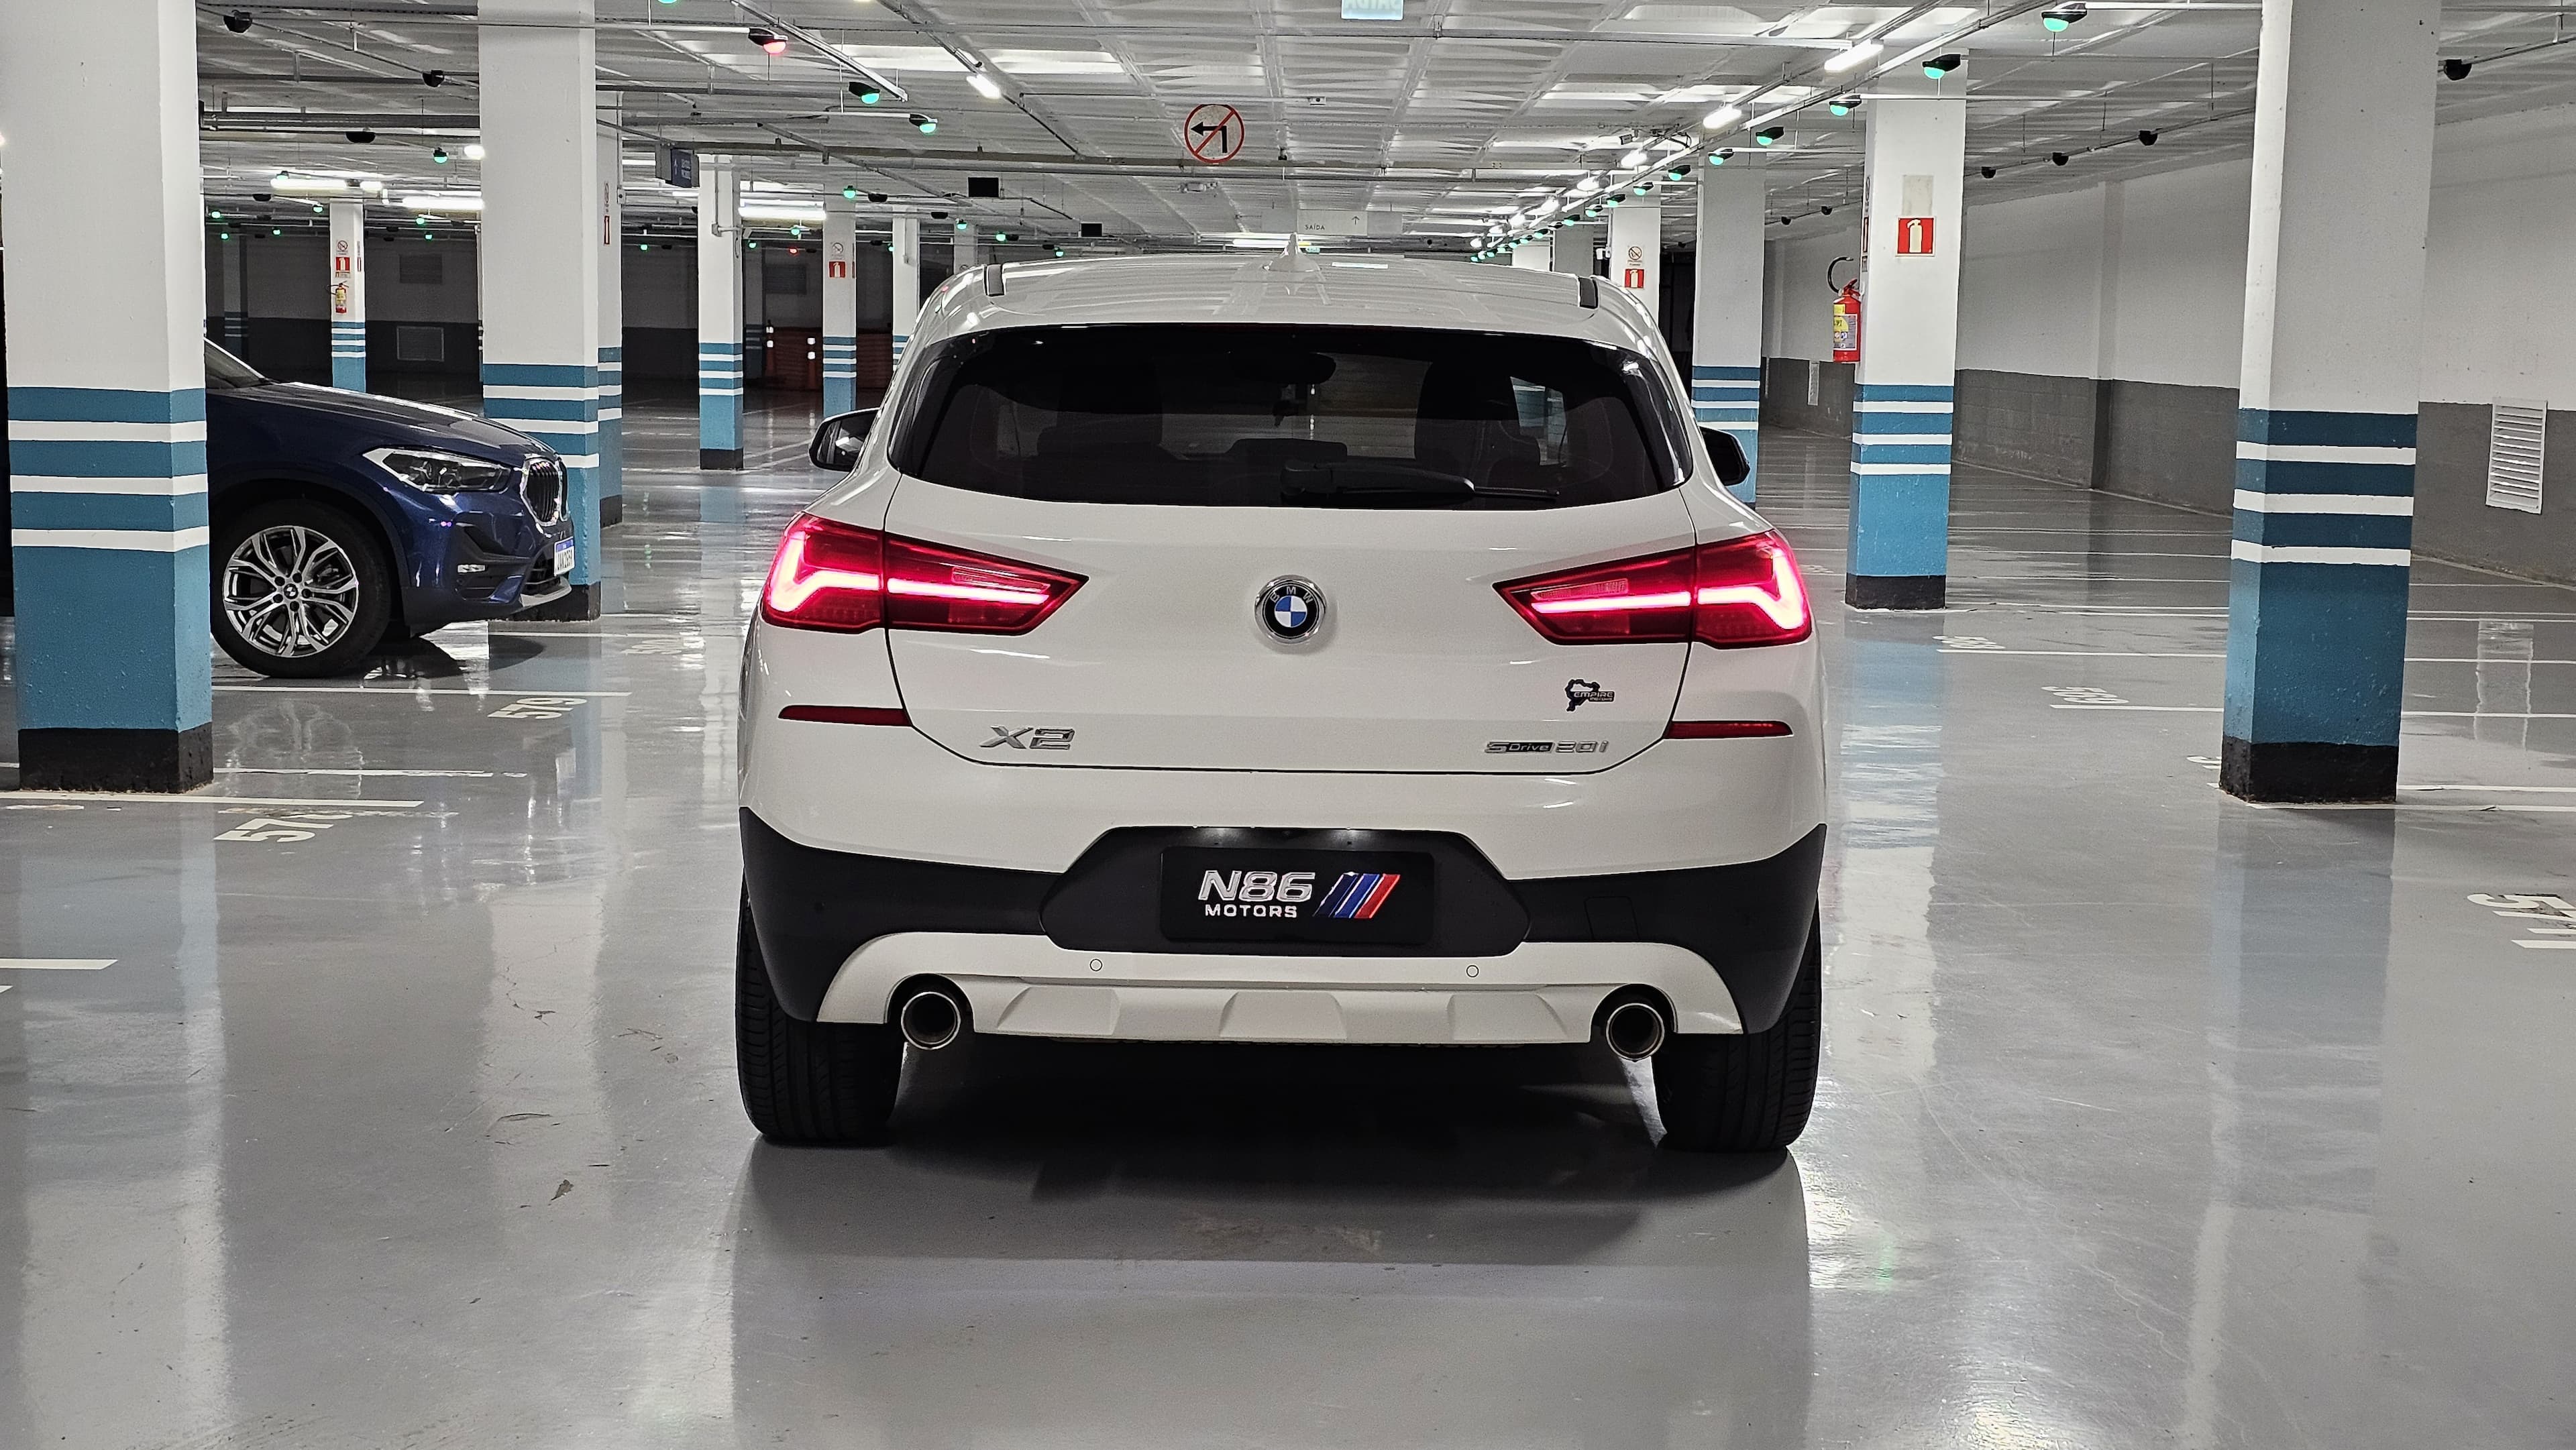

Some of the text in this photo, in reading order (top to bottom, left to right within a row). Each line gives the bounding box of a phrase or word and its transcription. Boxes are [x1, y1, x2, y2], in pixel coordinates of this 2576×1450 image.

[1270, 586, 1313, 604] BMW
[1932, 636, 2006, 649] 568
[2041, 686, 2129, 704] 569
[488, 697, 588, 720] 579
[979, 724, 1075, 750] X2
[1198, 870, 1316, 902] N86
[1205, 905, 1297, 918] MOTORS
